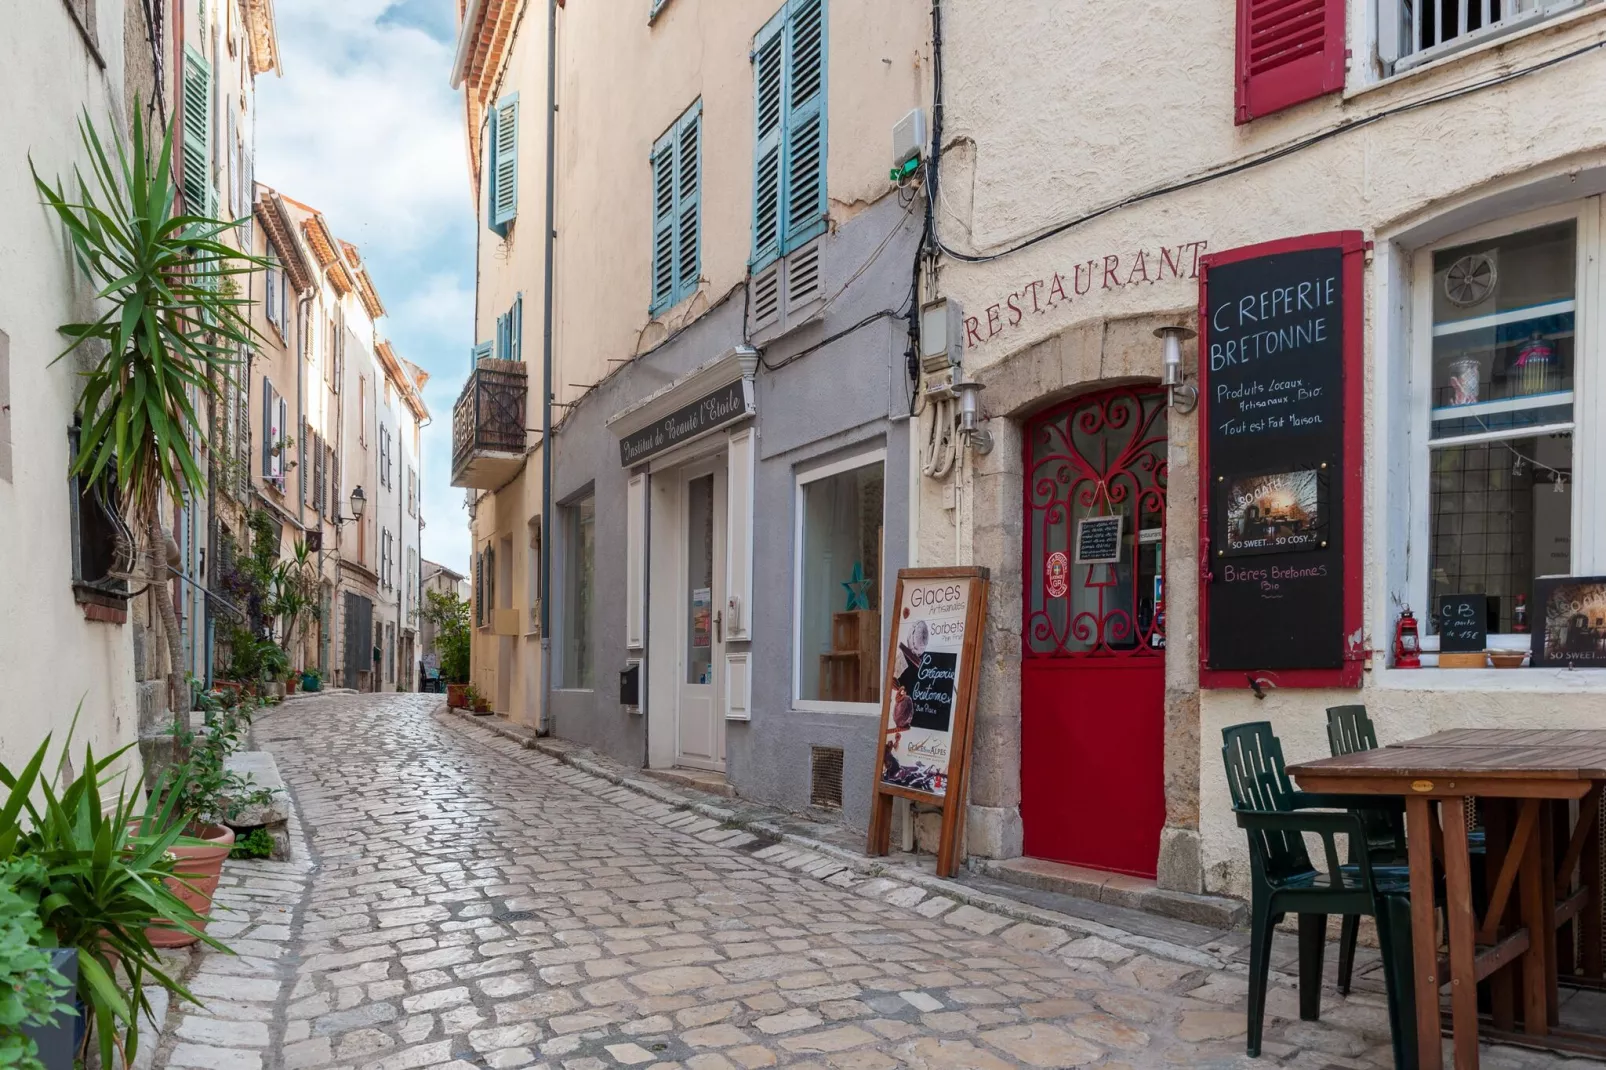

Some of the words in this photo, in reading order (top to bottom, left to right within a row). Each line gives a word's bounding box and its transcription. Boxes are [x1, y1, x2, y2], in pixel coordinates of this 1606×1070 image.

[964, 240, 1207, 349] RESTAURANT
[1211, 317, 1328, 372] BRETONNE
[1217, 381, 1264, 403] Produits
[1219, 419, 1246, 435] Tout
[1249, 419, 1265, 433] est
[1268, 416, 1285, 428] Fait
[1289, 413, 1323, 427] Maison
[623, 437, 653, 461] Institut
[654, 427, 664, 446] de
[664, 412, 698, 440] Beauté
[1239, 493, 1254, 507] SO
[1232, 541, 1242, 549] SO
[1275, 537, 1285, 545] SO
[910, 584, 961, 607] Glaces
[1260, 581, 1280, 591] Bio
[930, 620, 964, 636] Sorbets
[1550, 652, 1563, 660] SO
